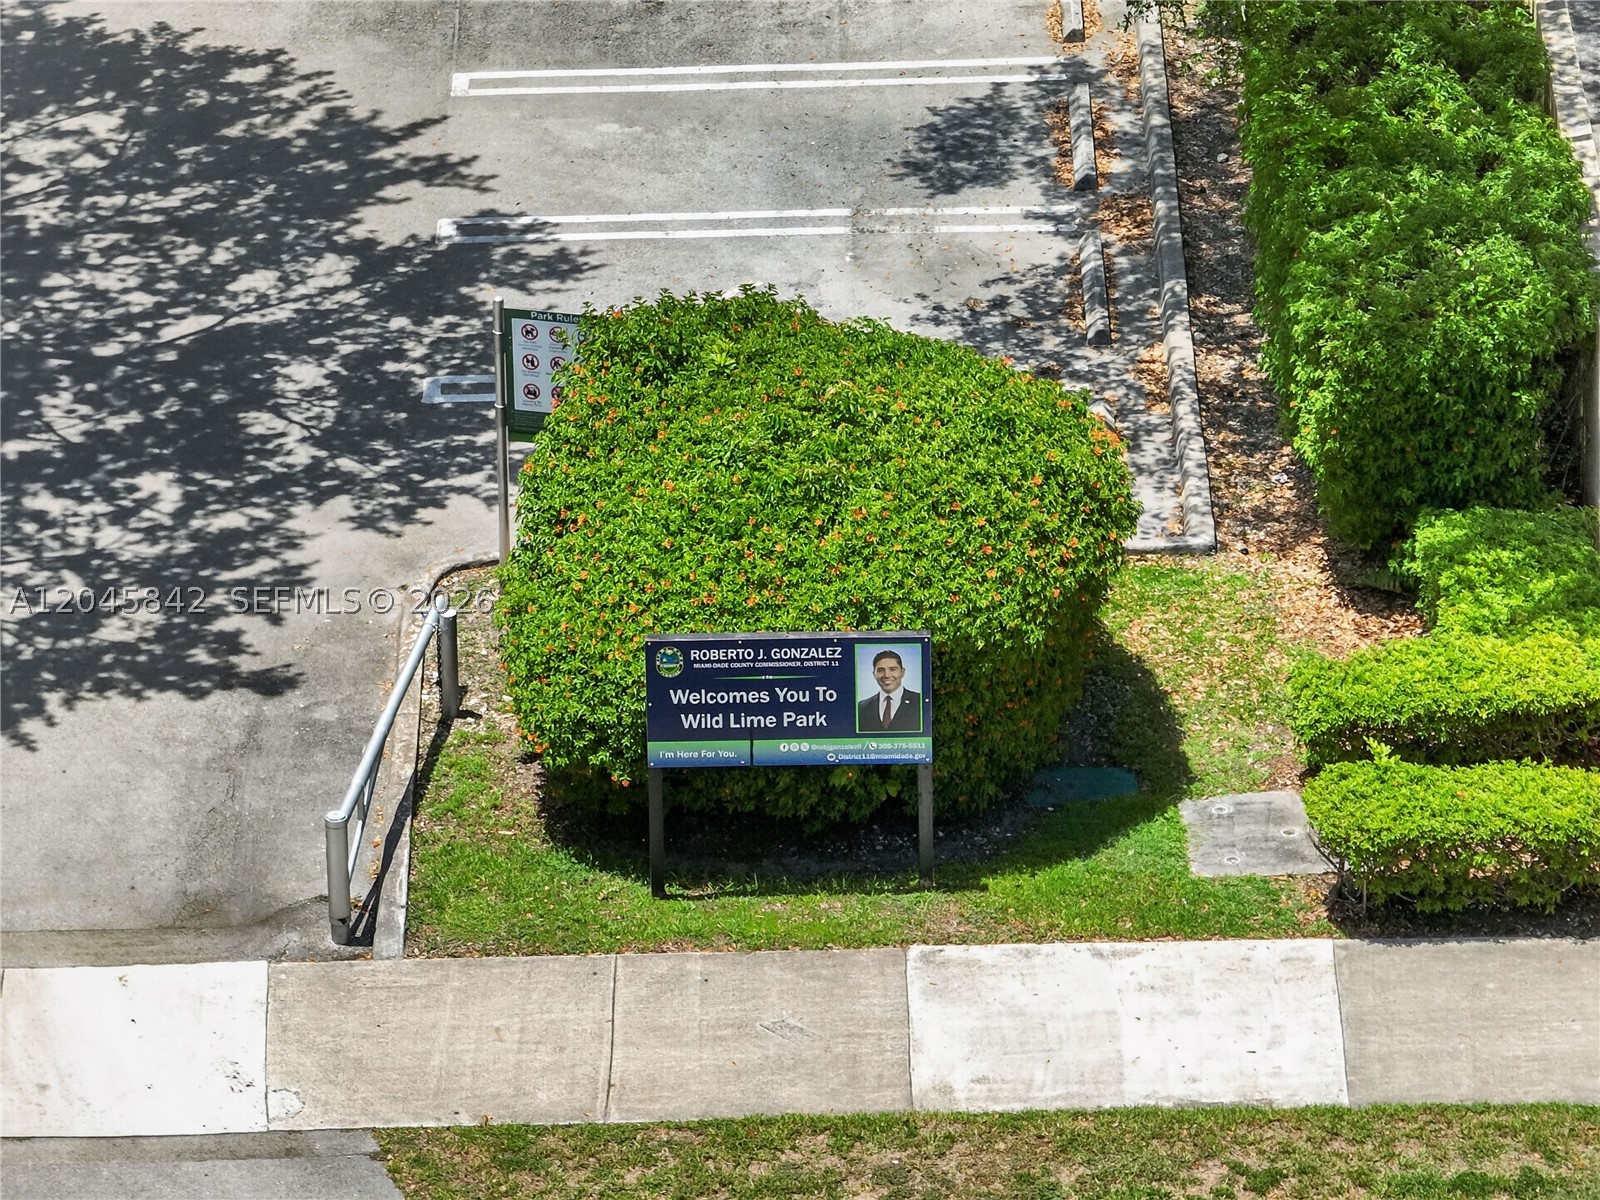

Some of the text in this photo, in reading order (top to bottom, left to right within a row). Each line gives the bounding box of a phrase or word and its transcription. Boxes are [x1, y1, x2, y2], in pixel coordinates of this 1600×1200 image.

[530, 311, 579, 323] Park Rule
[690, 648, 755, 661] ROBERTO
[757, 648, 767, 660] J.
[770, 647, 843, 659] GONZALEZ
[669, 686, 838, 705] Welcomes You To
[680, 711, 828, 729] Wild Lime Park
[659, 749, 738, 759] I'm Here For You.
